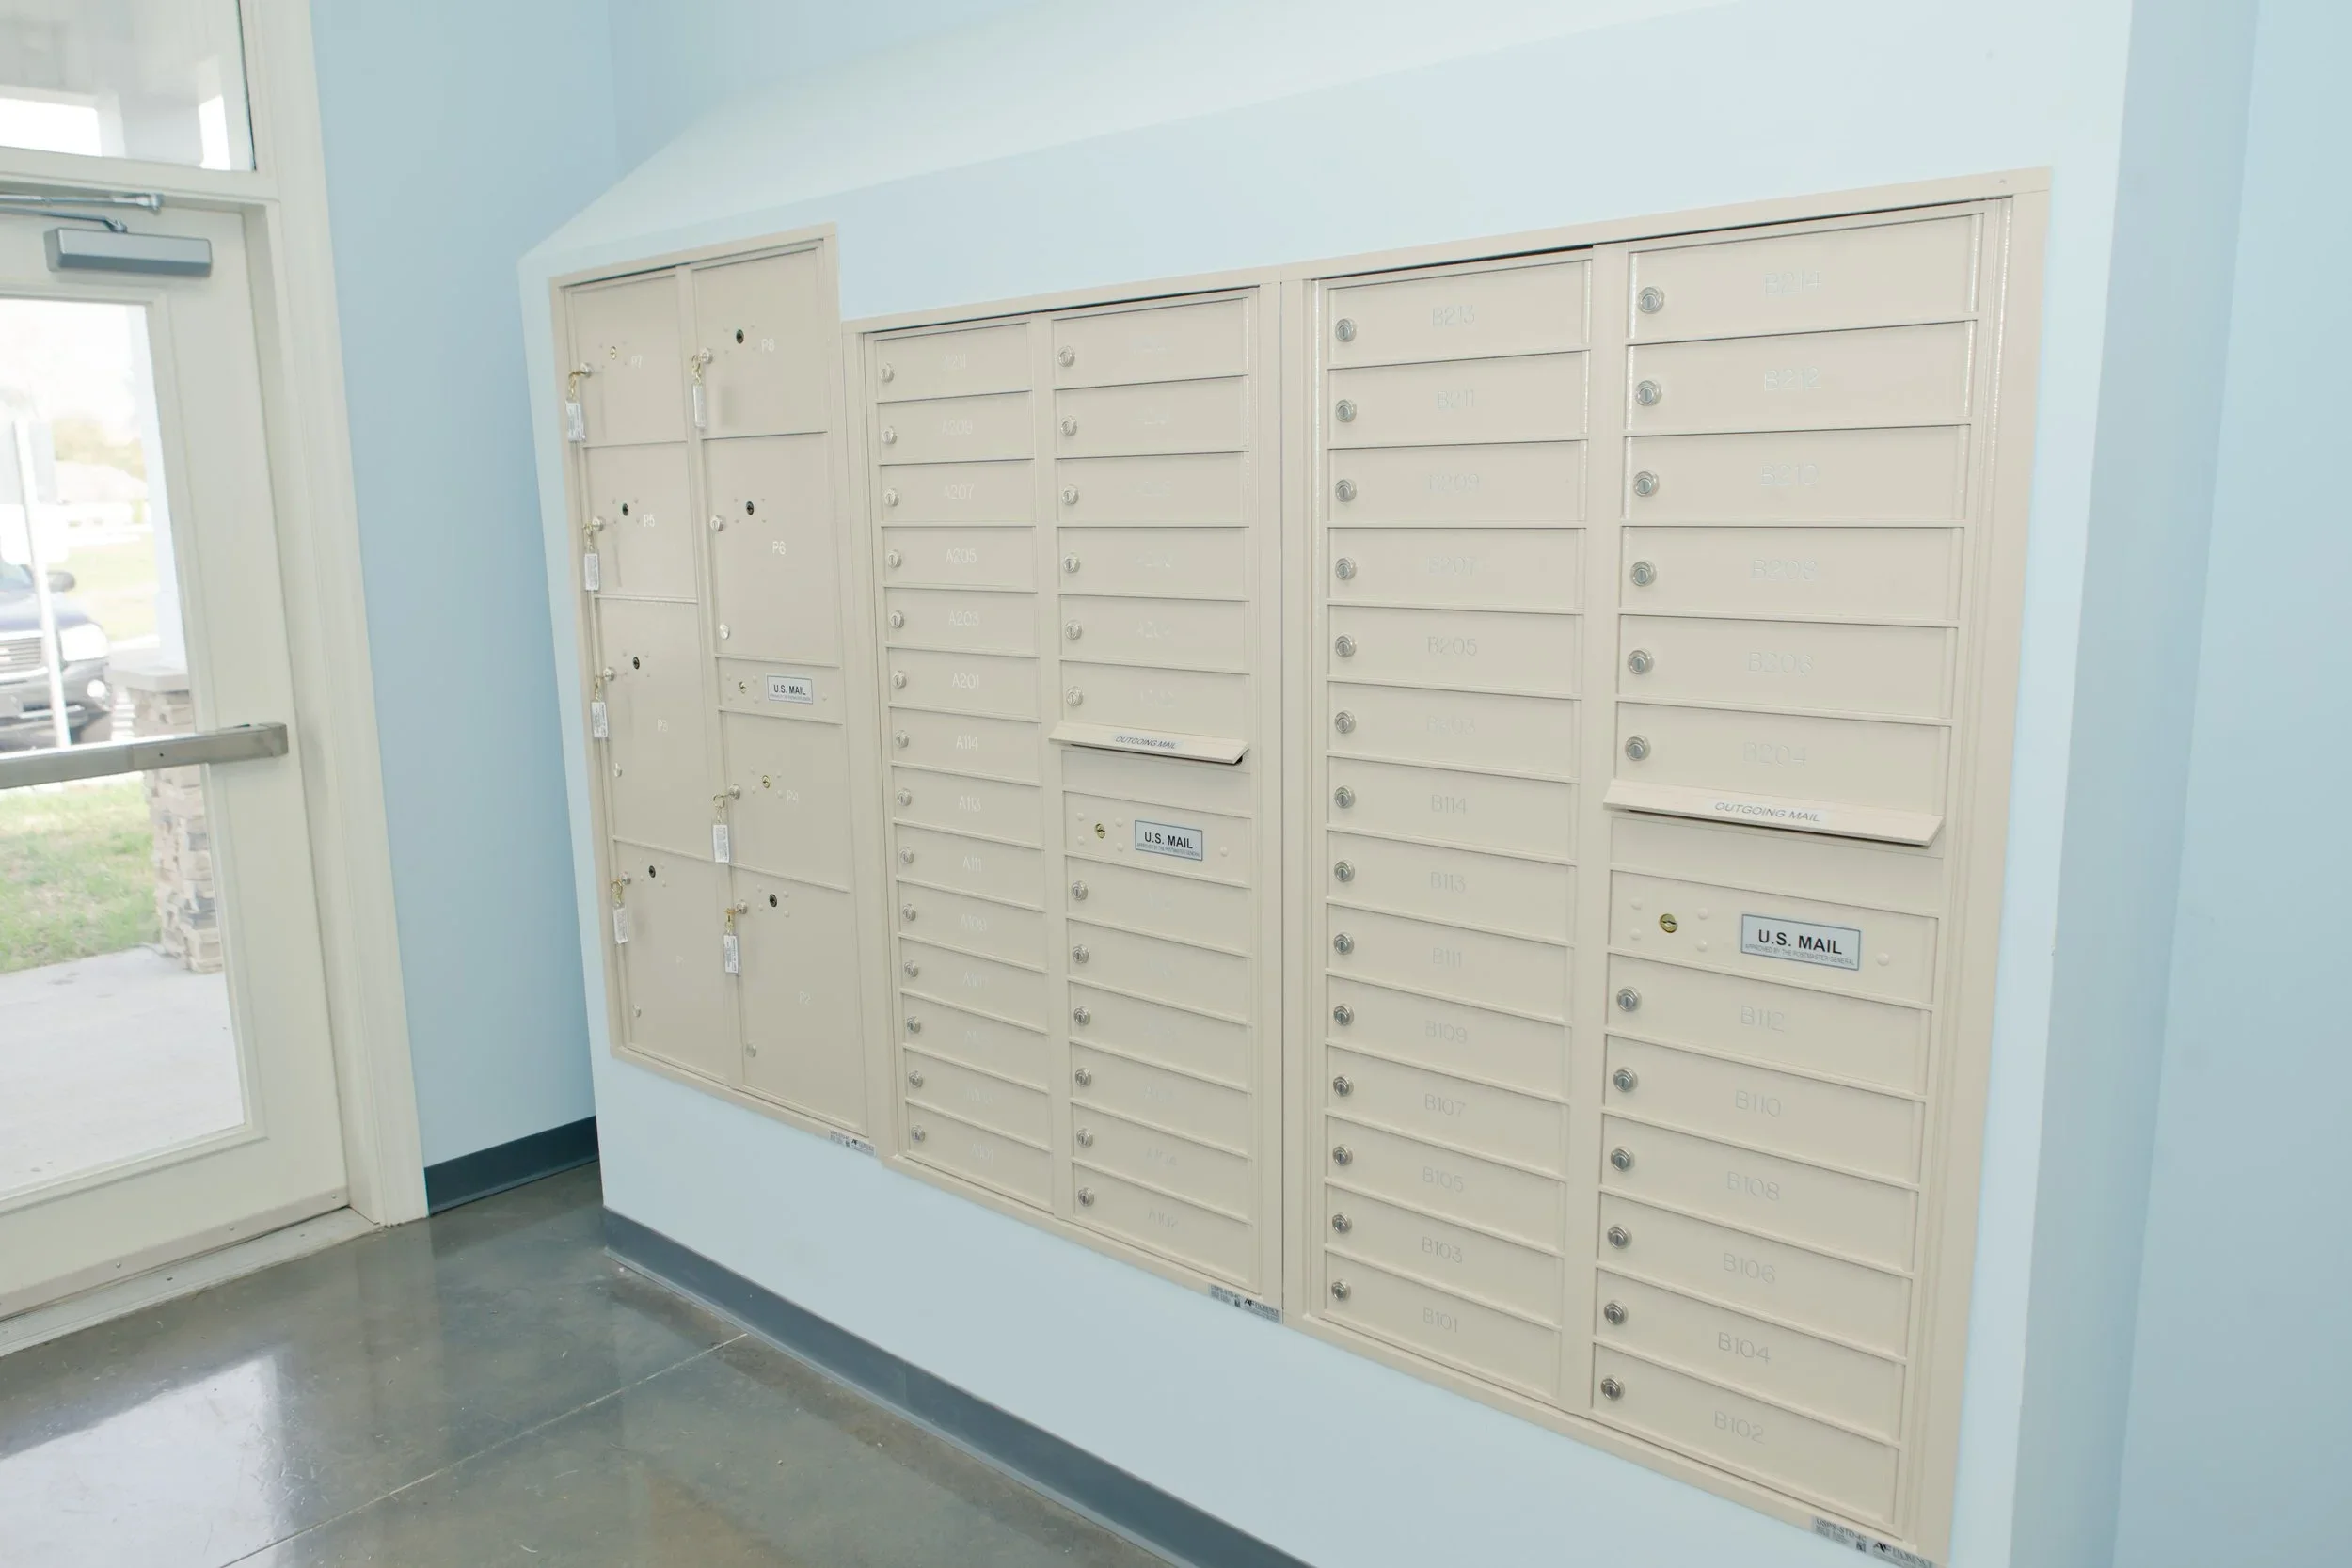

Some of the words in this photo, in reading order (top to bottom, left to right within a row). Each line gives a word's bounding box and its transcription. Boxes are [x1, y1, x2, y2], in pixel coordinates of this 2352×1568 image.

[1764, 268, 1822, 295] B214
[1431, 305, 1475, 327] B213
[761, 338, 775, 354] P8
[1764, 366, 1822, 392] B212
[1760, 463, 1819, 487] B210
[944, 483, 975, 500] A207
[772, 540, 787, 555] P6
[946, 547, 977, 564] A205
[948, 610, 980, 626] A203
[1427, 636, 1477, 657] B205
[788, 685, 806, 696] MAIL
[951, 673, 979, 689] A201
[956, 734, 979, 752] A114
[1115, 736, 1157, 747] OUTGOING
[1157, 740, 1176, 750] MAIL
[1431, 794, 1467, 815] B114
[1714, 801, 1786, 818] OUTGOING
[1788, 810, 1820, 822] MAIL
[1144, 831, 1164, 845] U.S.
[1167, 834, 1193, 849] MAIL
[1430, 871, 1466, 894] B113
[1758, 928, 1791, 947] U.S.
[1798, 935, 1842, 955] MAIL
[1432, 946, 1462, 969] B111
[1740, 1005, 1785, 1033] B112
[1425, 1020, 1468, 1044] B109
[1424, 1093, 1467, 1117] B107
[1735, 1089, 1782, 1119] B110
[1422, 1165, 1464, 1193] B105
[1727, 1171, 1780, 1202] B108
[1422, 1235, 1463, 1265] B103
[1723, 1252, 1775, 1284] B106
[1422, 1306, 1458, 1334] B101
[1717, 1331, 1771, 1364] B104
[1714, 1410, 1765, 1445] B102
